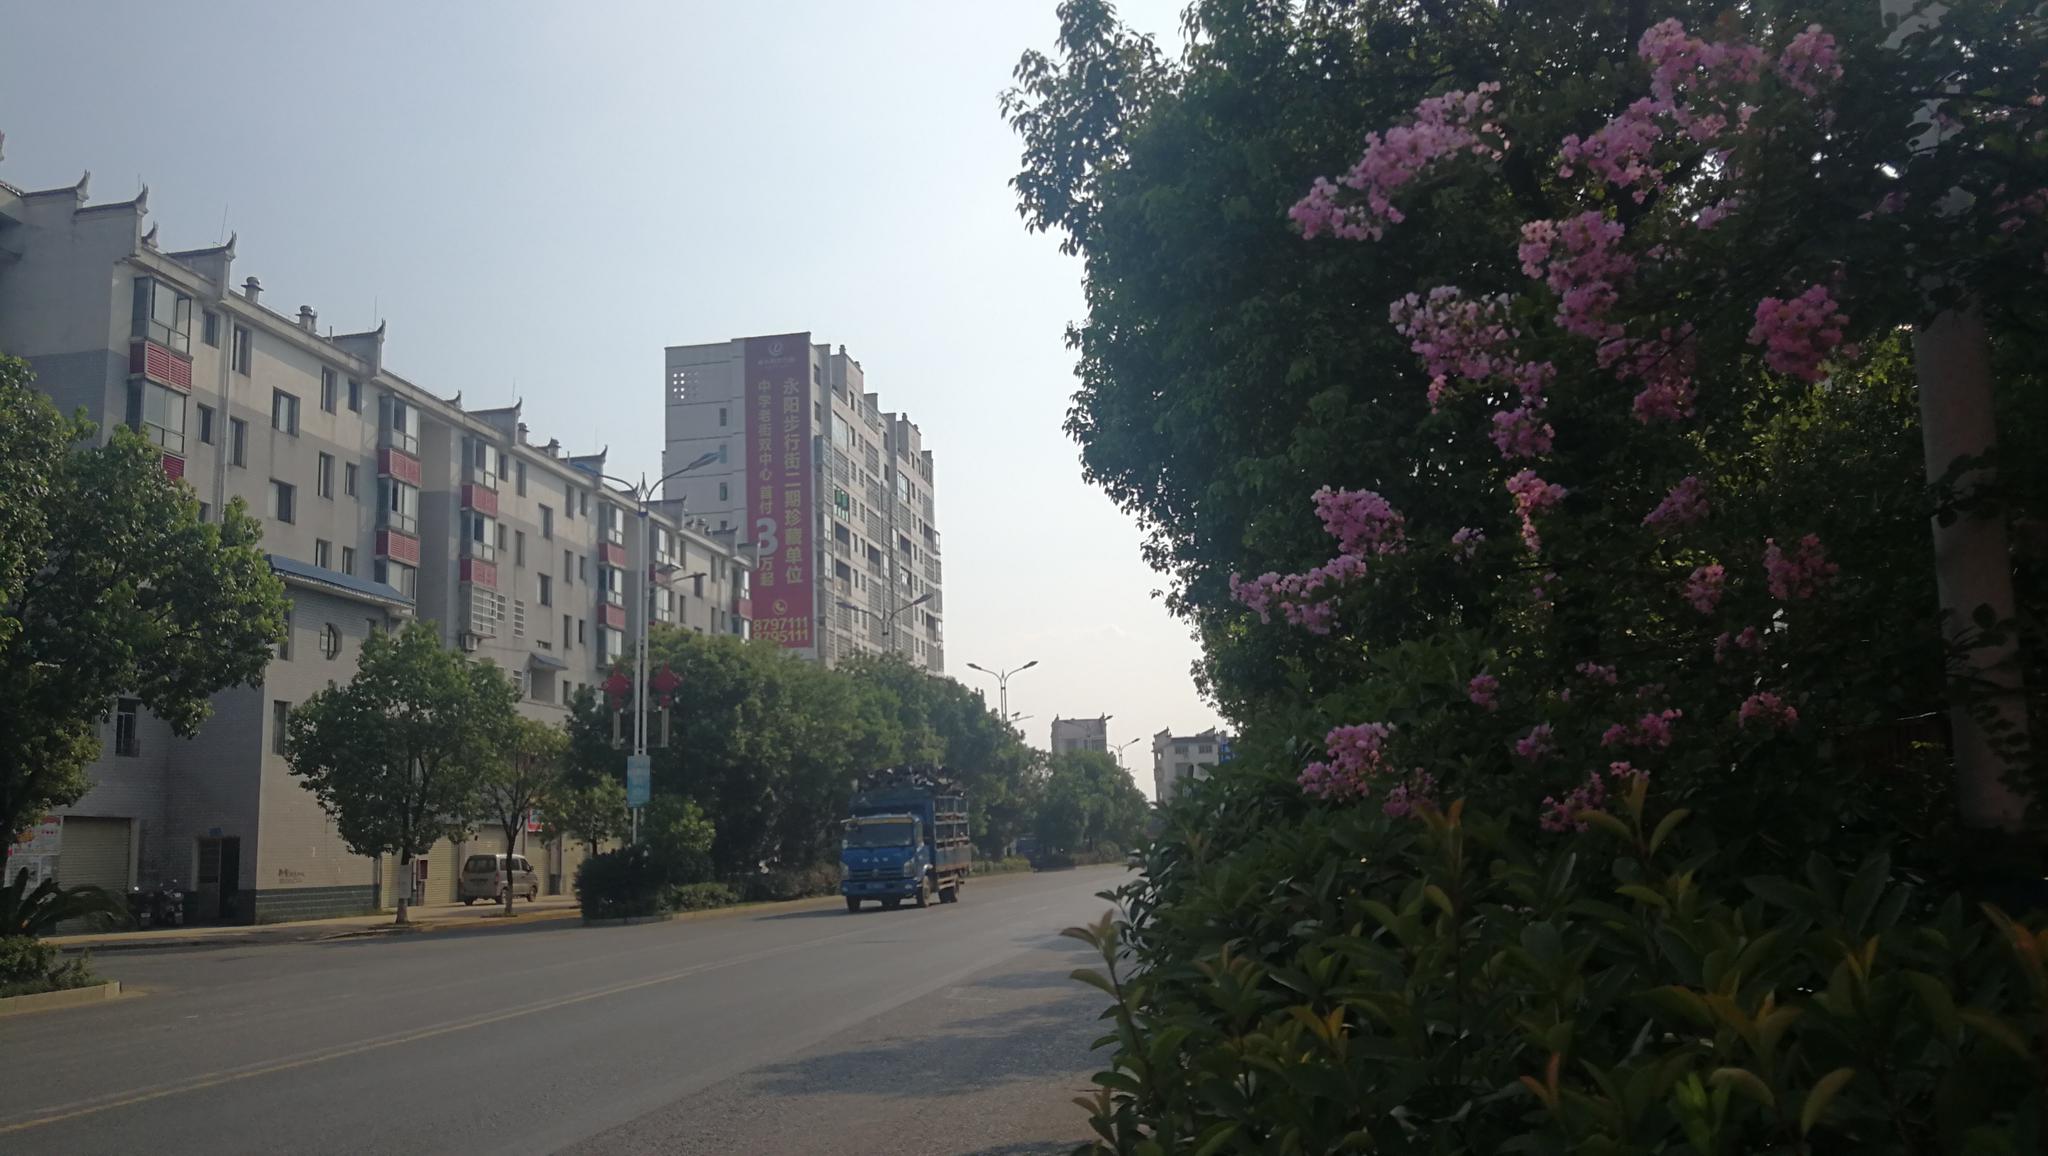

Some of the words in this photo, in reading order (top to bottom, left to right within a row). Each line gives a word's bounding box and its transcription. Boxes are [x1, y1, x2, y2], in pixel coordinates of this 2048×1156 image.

[782, 376, 804, 584] 永阳步行街二期珍藏单位
[753, 616, 808, 632] 8797111
[753, 629, 808, 642] 8795111
